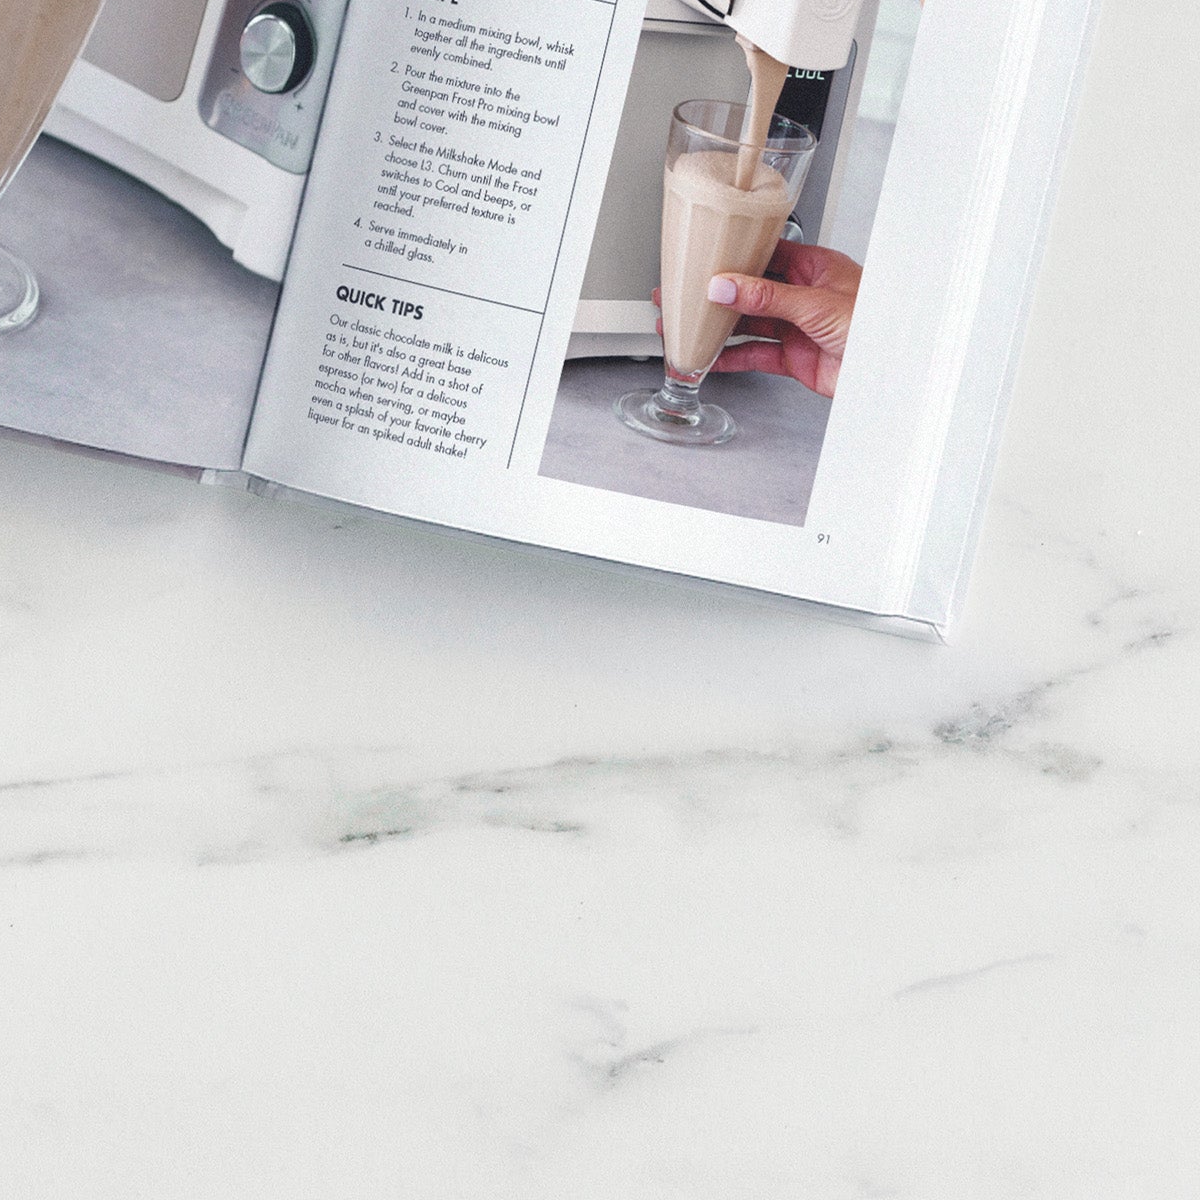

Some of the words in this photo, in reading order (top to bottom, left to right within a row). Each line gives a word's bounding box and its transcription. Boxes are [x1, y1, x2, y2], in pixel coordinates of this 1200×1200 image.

[405, 6, 411, 18] 1.
[418, 10, 426, 21] In
[429, 16, 436, 24] a
[438, 18, 475, 33] medium
[478, 27, 511, 44] mixing
[514, 31, 541, 50] bowl,
[546, 41, 574, 55] whisk
[410, 45, 440, 60] evenly
[443, 53, 492, 70] combined.
[390, 61, 398, 72] 2.
[405, 64, 425, 78] Pour
[428, 70, 443, 83] the
[445, 77, 480, 92] mixture
[483, 83, 502, 97] into
[505, 87, 520, 101] the
[393, 111, 417, 127] bowl
[419, 122, 447, 134] cover.
[397, 99, 416, 110] and
[418, 105, 444, 116] cover
[448, 110, 467, 122] with
[470, 113, 485, 126] the
[488, 120, 521, 138] mixing
[401, 80, 448, 101] Greenpan
[451, 91, 475, 107] Frost
[477, 97, 493, 111] Pro
[496, 105, 530, 123] mixing
[533, 110, 560, 126] bowl
[373, 131, 382, 142] 3.
[388, 135, 417, 150] Select
[419, 141, 433, 155] the
[435, 146, 485, 167] Milkshake
[487, 158, 517, 175] Mode
[520, 169, 542, 180] and
[384, 151, 417, 168] choose
[420, 159, 433, 172] L3.
[438, 163, 467, 180] Churn
[470, 174, 492, 185] until
[494, 176, 509, 189] the
[512, 180, 537, 196] Frost
[353, 217, 362, 228] 4.
[368, 220, 394, 235] Serve
[397, 228, 456, 253] immediately
[458, 243, 467, 254] in
[336, 285, 386, 310] QUICK
[392, 299, 423, 319] TIPS
[329, 314, 347, 327] Our
[350, 319, 381, 336] classic
[383, 328, 430, 349] chocolate
[432, 342, 453, 355] milk
[456, 346, 463, 357] is
[467, 348, 508, 367] delicous
[314, 380, 346, 394] mocha
[349, 387, 373, 401] when
[376, 396, 413, 414] serving,
[418, 407, 428, 415] or
[431, 410, 465, 424] maybe
[318, 364, 358, 380] espresso
[361, 372, 374, 385] (or
[376, 378, 397, 393] two)
[400, 381, 413, 394] for
[426, 388, 467, 408] delicous
[817, 533, 831, 545] 91
